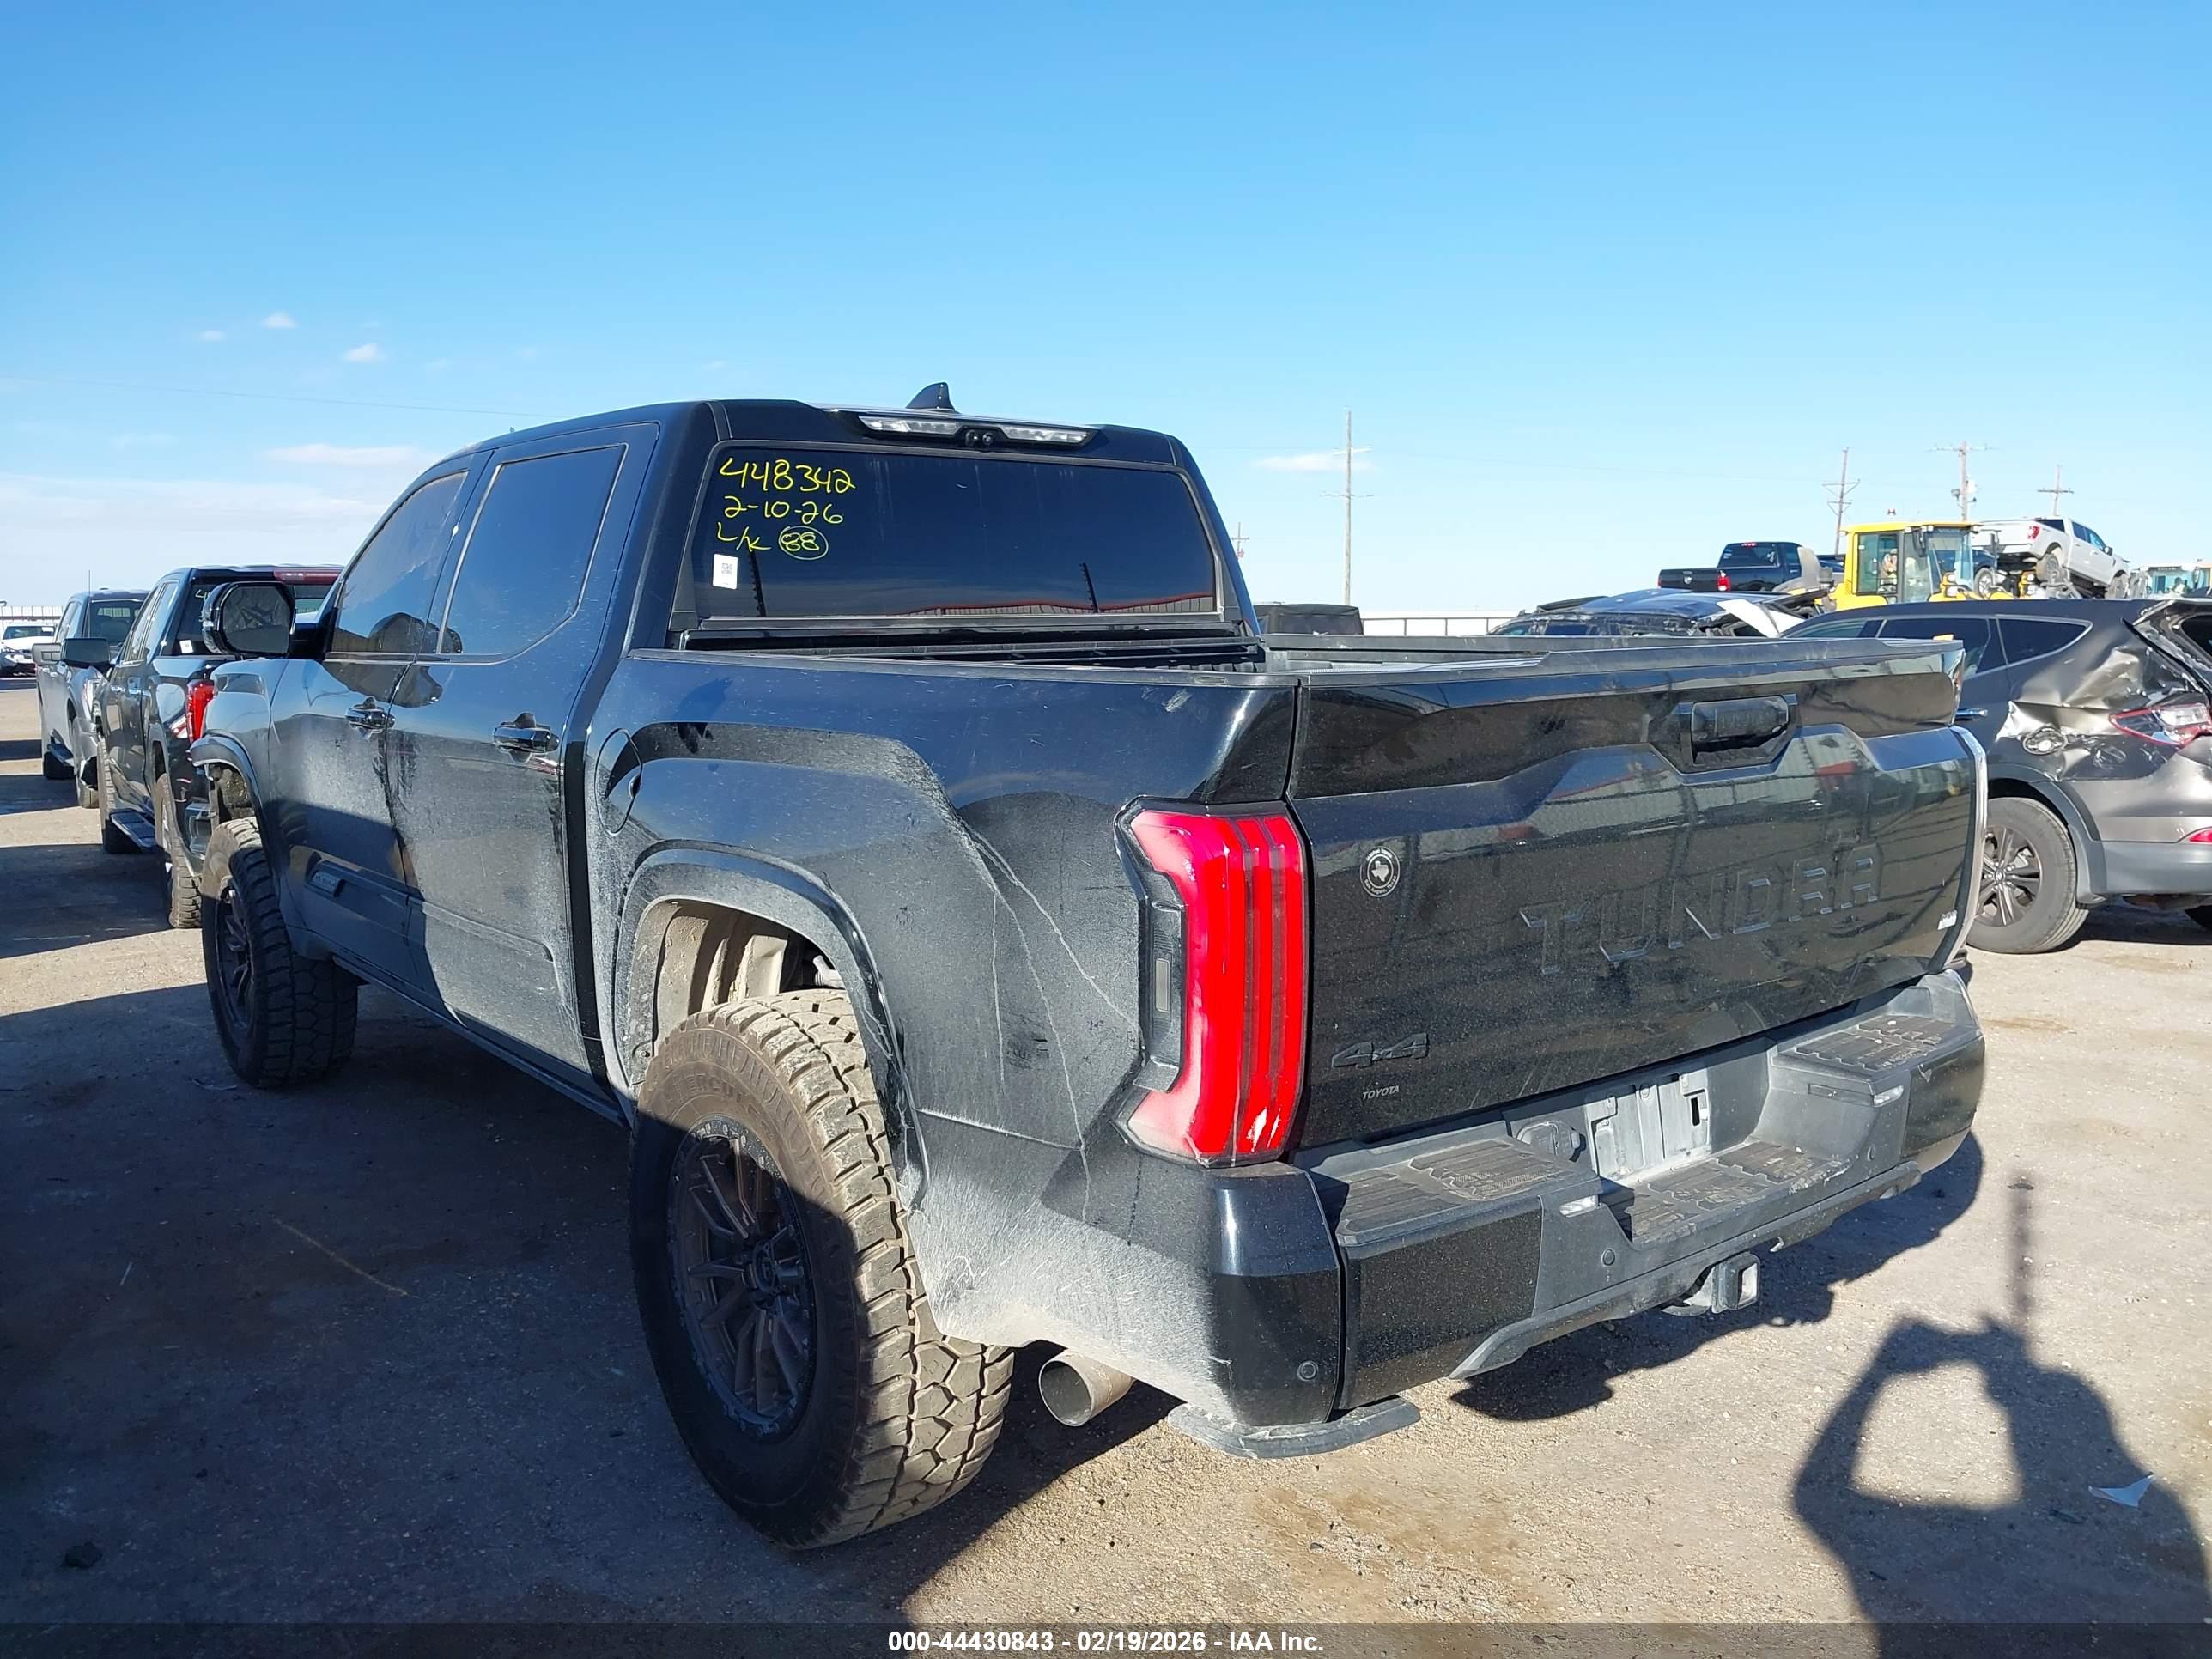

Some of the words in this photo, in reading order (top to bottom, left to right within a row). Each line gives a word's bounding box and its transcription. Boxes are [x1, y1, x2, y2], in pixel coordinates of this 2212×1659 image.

[719, 457, 856, 494] 448342
[724, 495, 843, 524] 2-10-26
[1518, 842, 1882, 975] TUNDRA
[1362, 1085, 1400, 1099] TOYOTA
